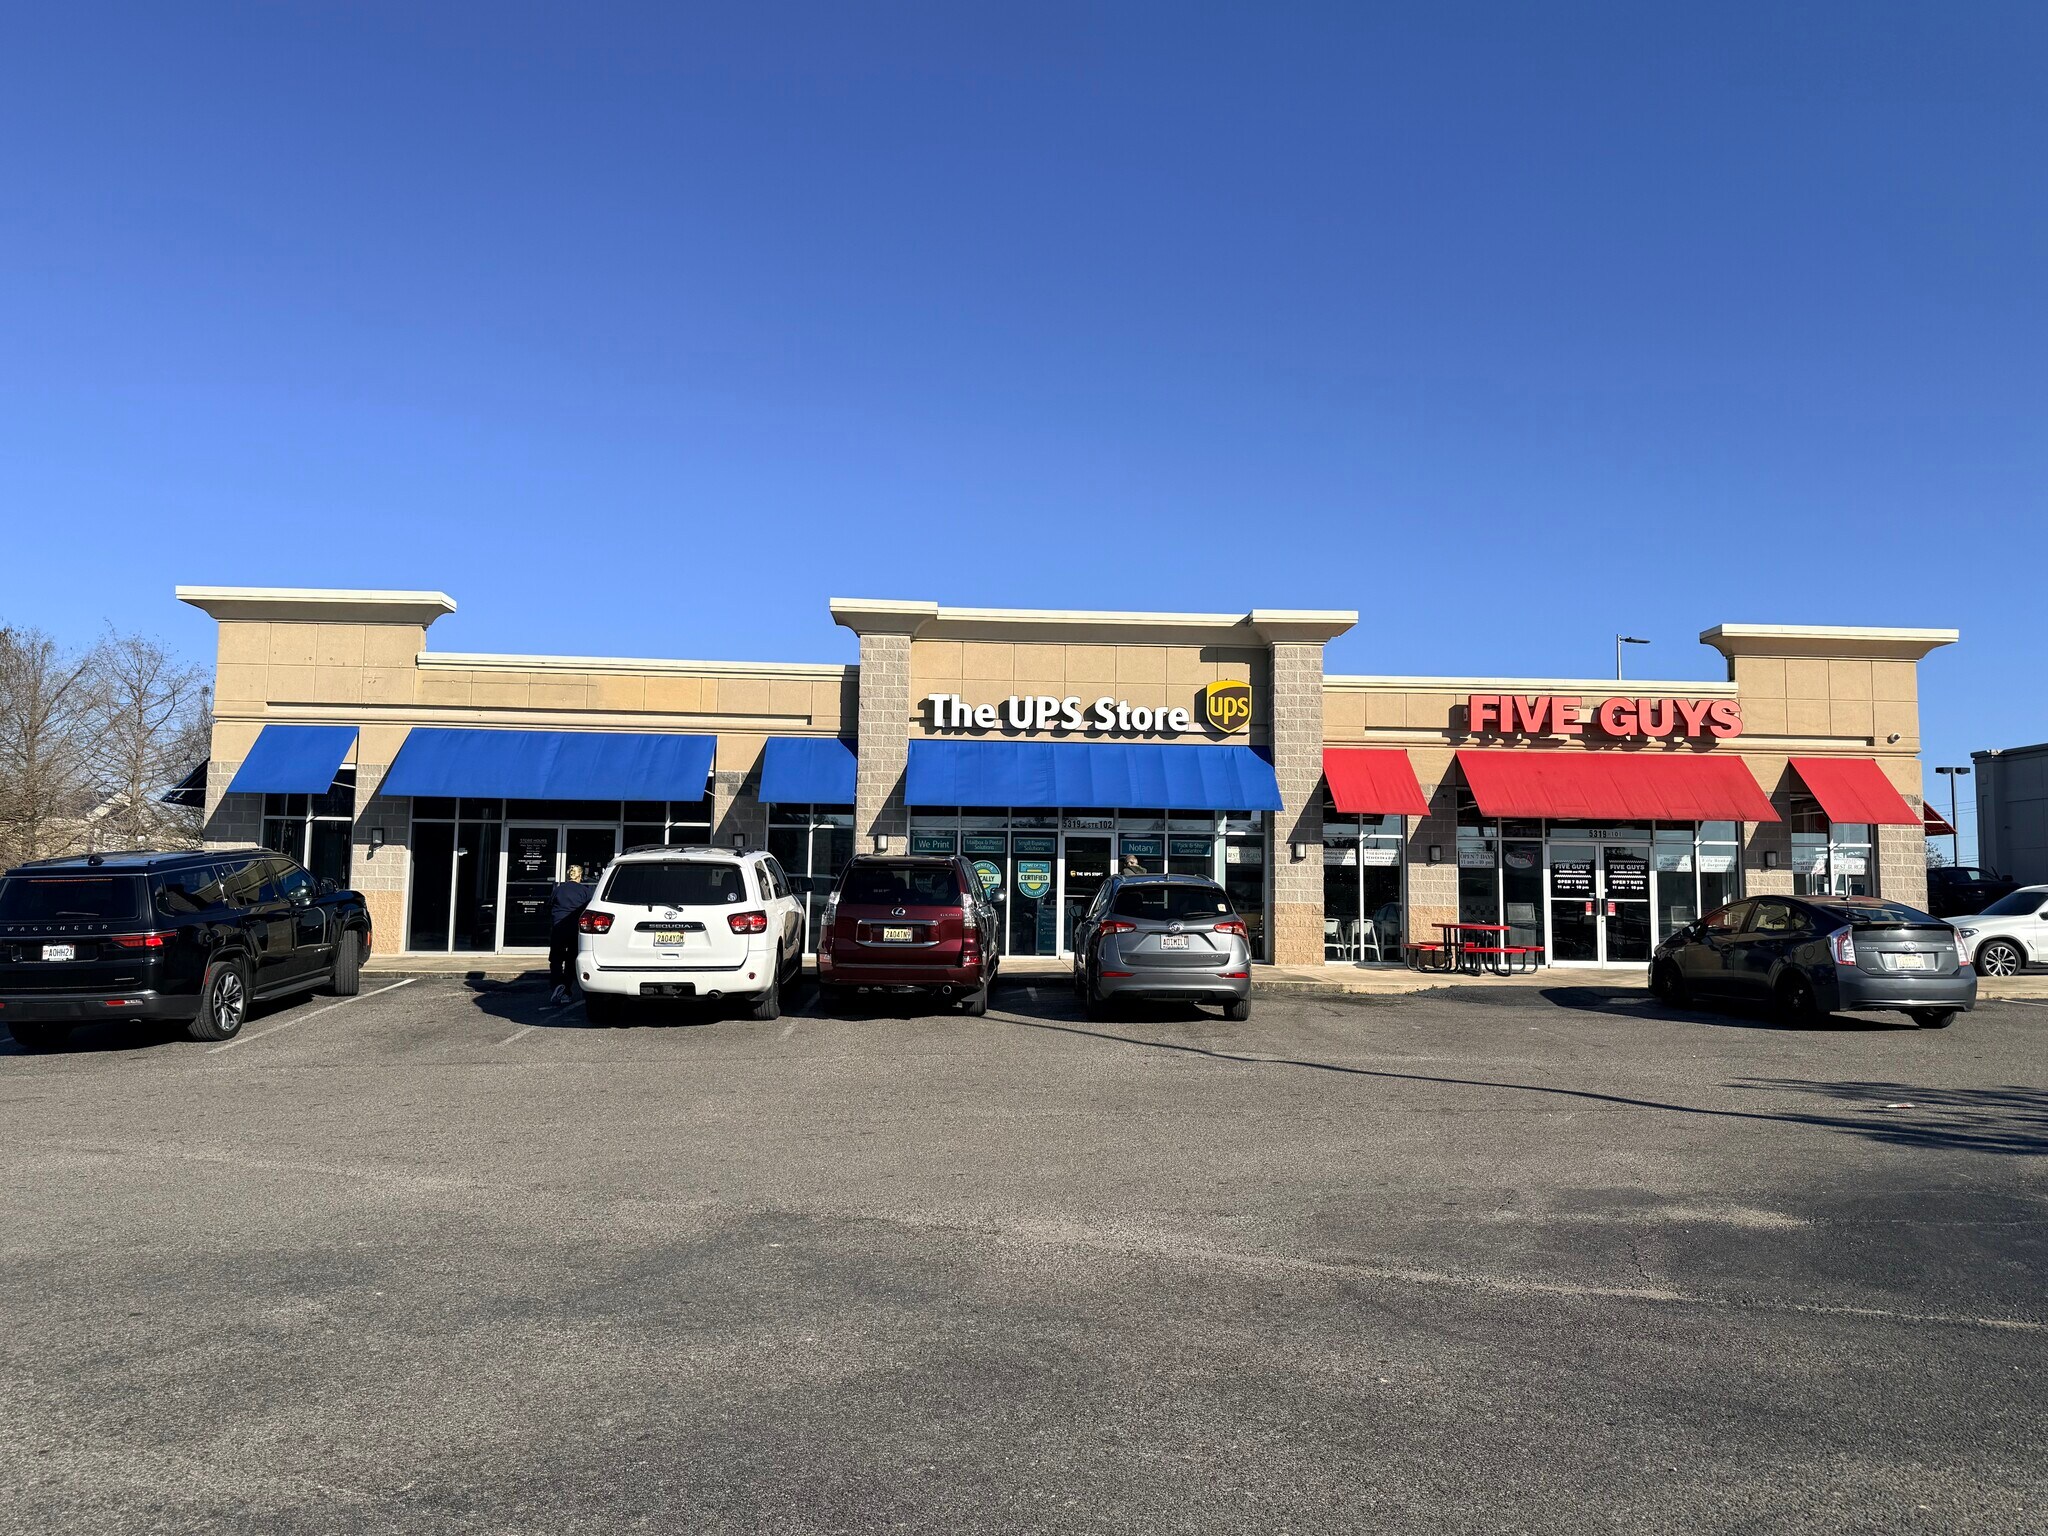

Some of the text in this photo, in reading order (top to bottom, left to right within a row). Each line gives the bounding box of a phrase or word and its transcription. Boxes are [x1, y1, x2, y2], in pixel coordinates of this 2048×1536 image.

[928, 694, 1190, 731] The UPS Store
[1211, 696, 1248, 724] ups
[1469, 695, 1743, 738] FIVE GUYS
[1099, 821, 1112, 829] 102
[1589, 830, 1607, 838] 5319
[918, 840, 950, 849] We Print
[1128, 843, 1154, 853] Notary
[7, 924, 108, 932] WAGONEER
